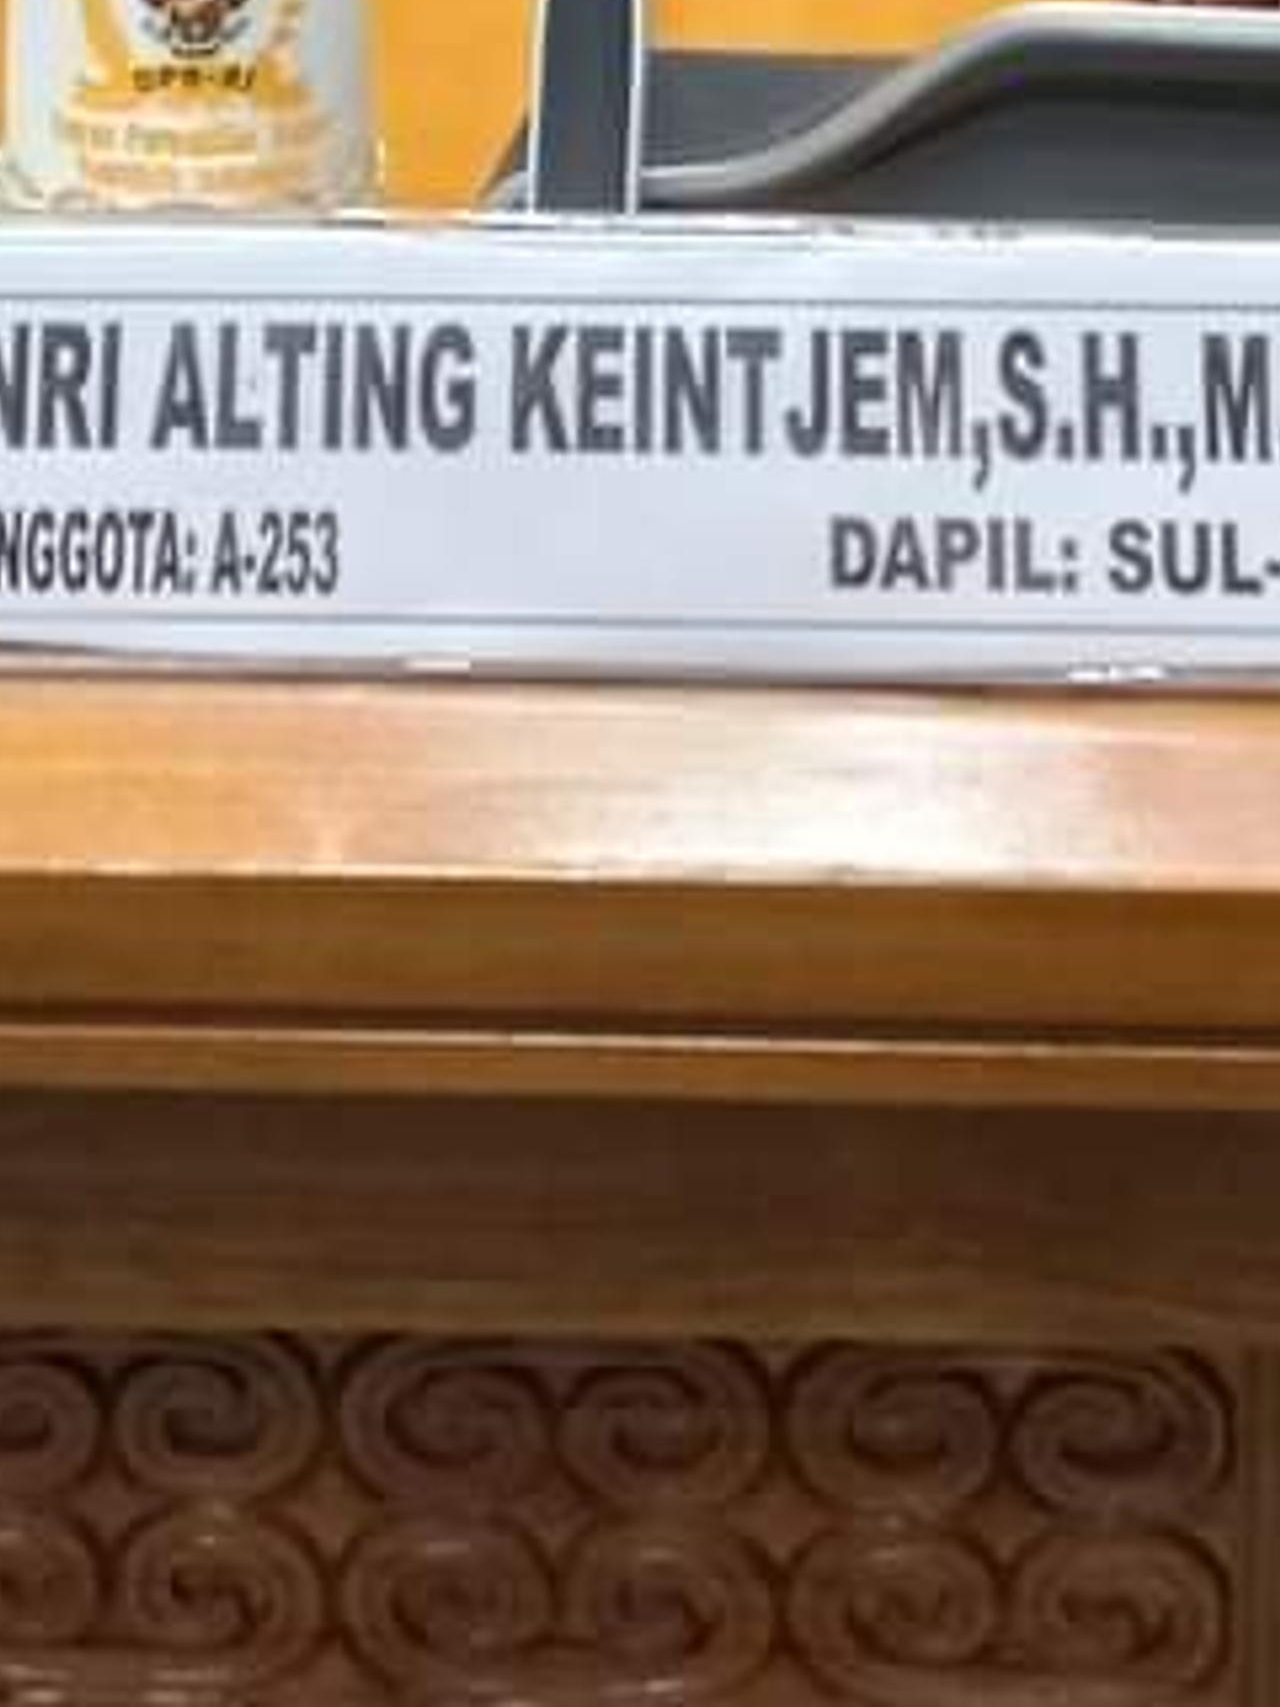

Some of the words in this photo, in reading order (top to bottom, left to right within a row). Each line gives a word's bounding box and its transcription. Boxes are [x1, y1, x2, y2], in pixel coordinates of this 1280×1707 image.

[149, 322, 476, 453] ALTING
[211, 511, 340, 594] A-253
[829, 516, 1078, 593] DAPIL:
